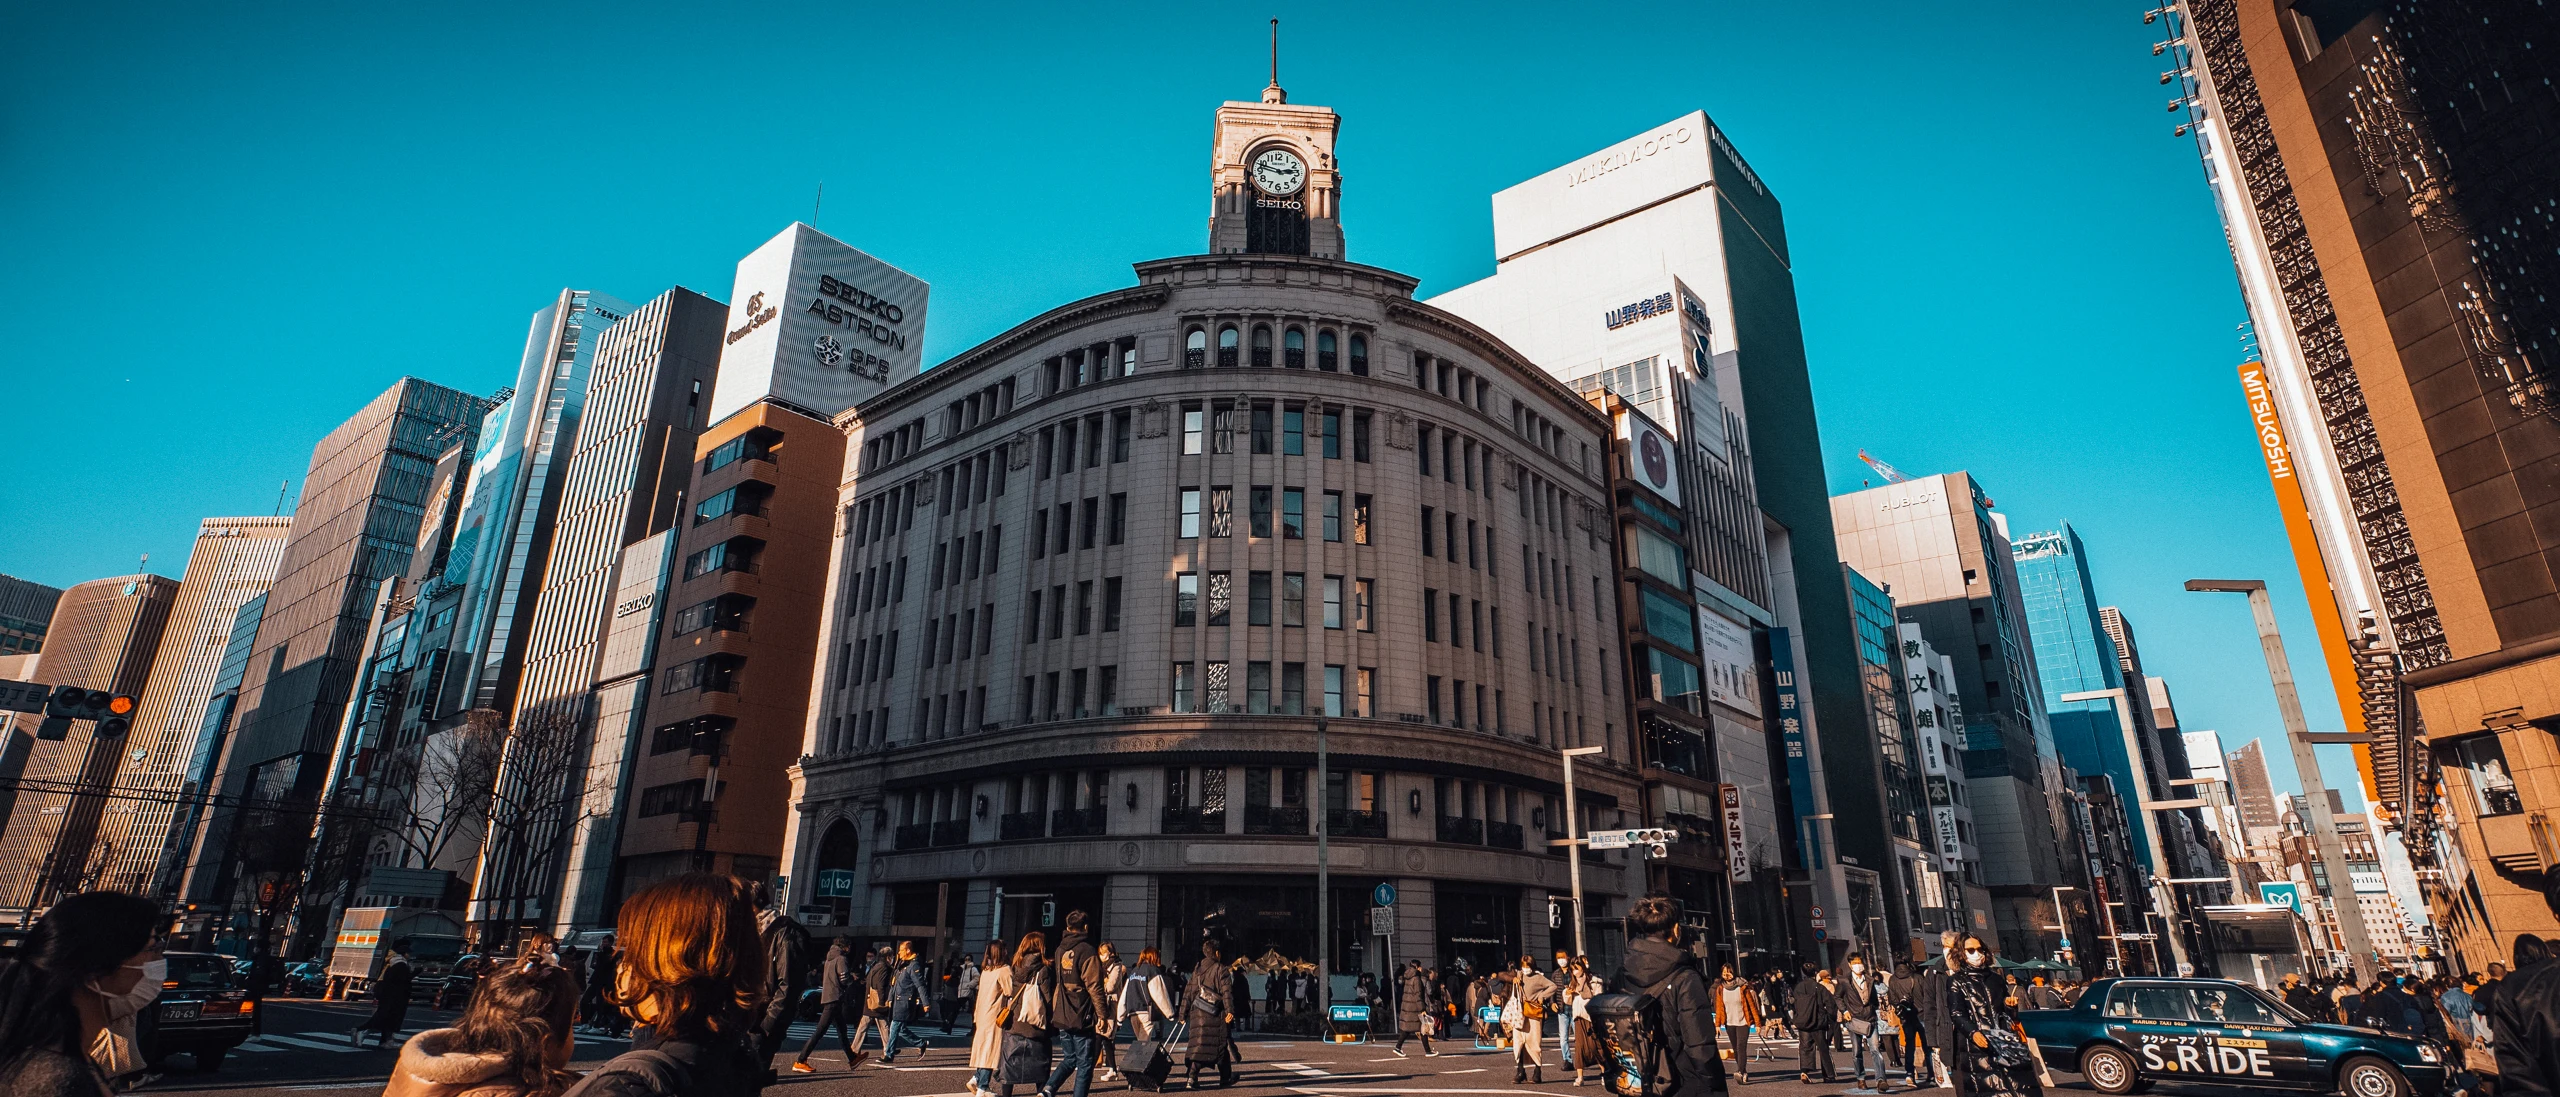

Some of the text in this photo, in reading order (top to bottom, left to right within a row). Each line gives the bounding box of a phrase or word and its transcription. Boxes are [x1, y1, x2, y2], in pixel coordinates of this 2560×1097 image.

[1267, 154, 1274, 163] 11
[1274, 153, 1283, 161] 12
[1290, 161, 1297, 169] 2
[1568, 127, 1692, 188] MIKIMOTO
[1259, 174, 1267, 182] 8
[1267, 180, 1274, 188] 7
[1274, 183, 1281, 191] 6
[1283, 181, 1290, 190] 5
[1290, 176, 1298, 185] 4
[1256, 199, 1302, 210] SEIKO
[818, 273, 904, 325] SEIKO
[1605, 291, 1675, 332] 山野楽器
[807, 297, 906, 351] ASTRON
[850, 347, 889, 374] GPS
[849, 362, 888, 385] SOLAR
[2243, 369, 2291, 479] MITSUKOSHI
[1880, 492, 1937, 512] HUBLOT
[616, 592, 655, 619] SEIKO
[1904, 639, 1935, 729] 教文館
[1776, 671, 1803, 758] 山野楽器
[1929, 780, 1947, 802] 本
[1591, 835, 1625, 843] 銀座四丁目
[1727, 811, 1746, 878] キムラヤのパン
[169, 1010, 194, 1018] 70-69
[2142, 1043, 2274, 1077] S.RIDE
